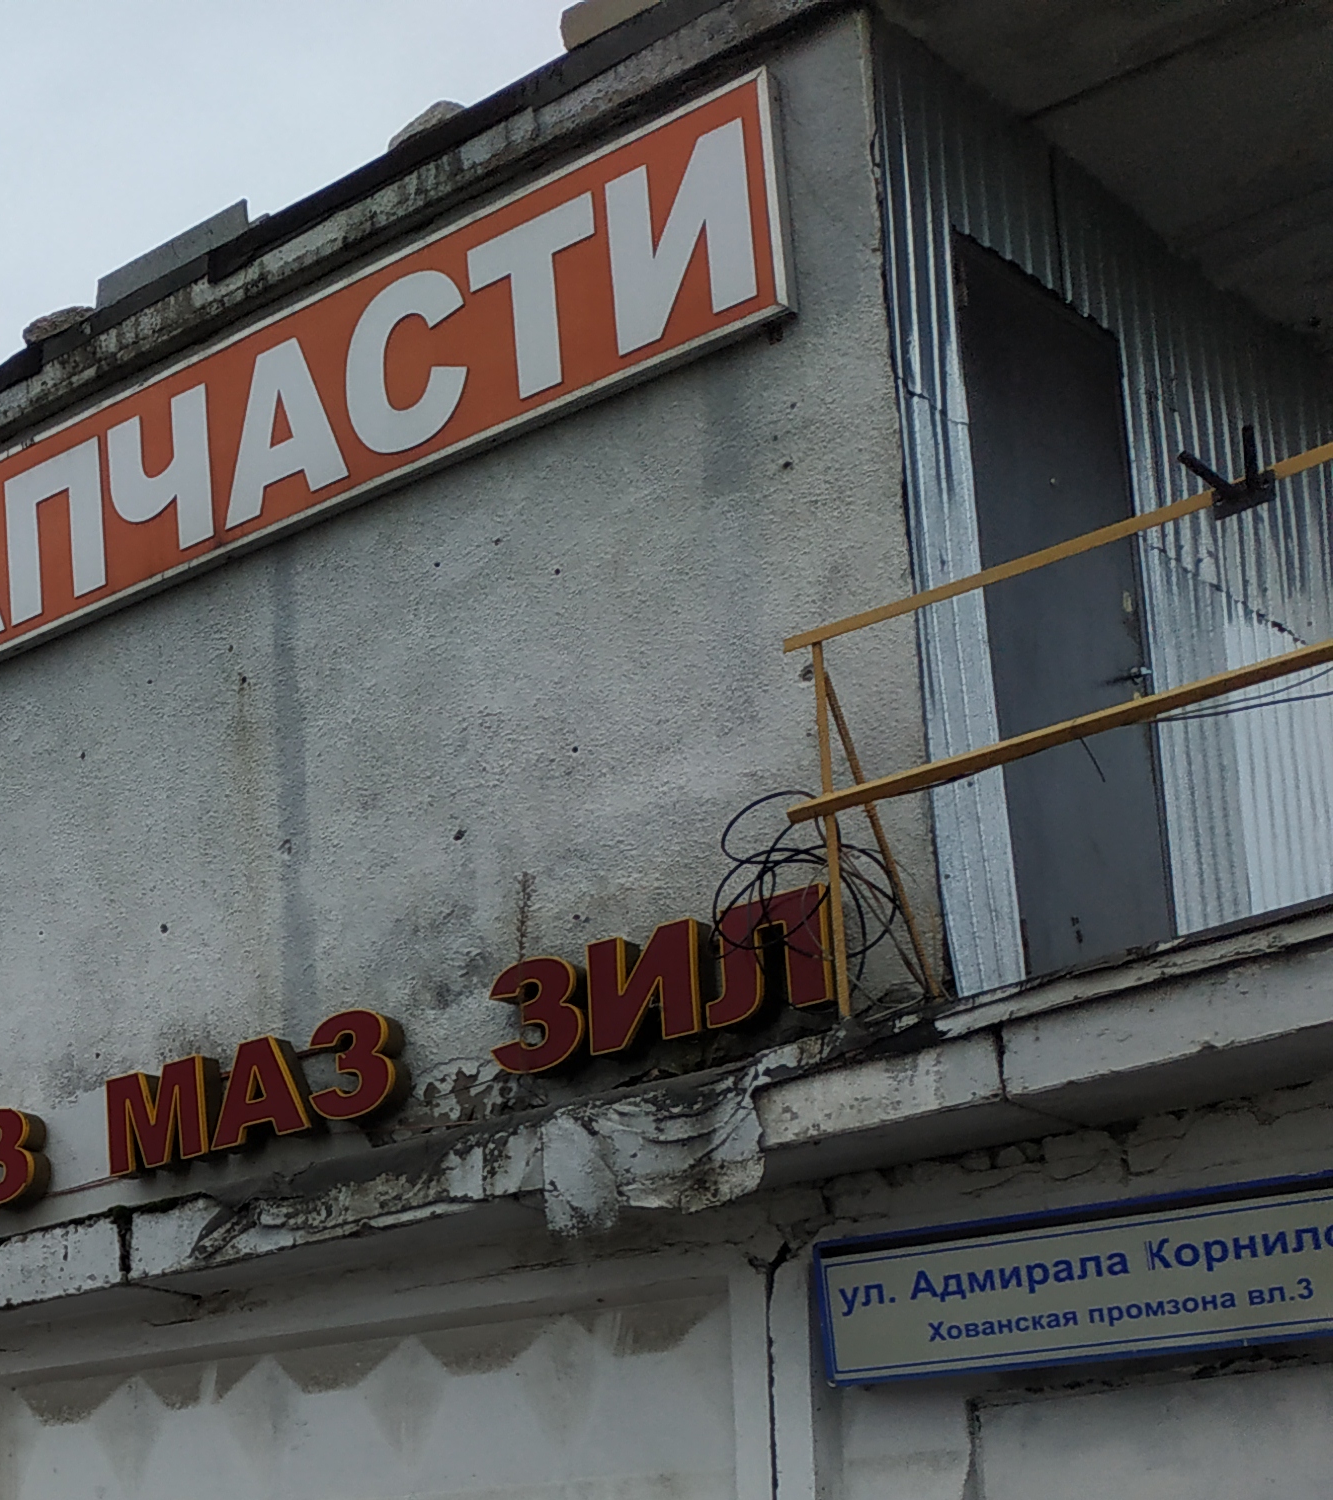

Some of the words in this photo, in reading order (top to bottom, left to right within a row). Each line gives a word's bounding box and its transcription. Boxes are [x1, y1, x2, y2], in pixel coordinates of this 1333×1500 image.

[105, 1008, 401, 1179] МАЗ
[489, 882, 835, 1075] ЗИЛ
[838, 1283, 896, 1316] ул.
[910, 1250, 1130, 1302] Адмирала
[928, 1309, 1078, 1342] Хованская
[1089, 1288, 1237, 1327] промзона
[1248, 1277, 1314, 1307] вл.3
